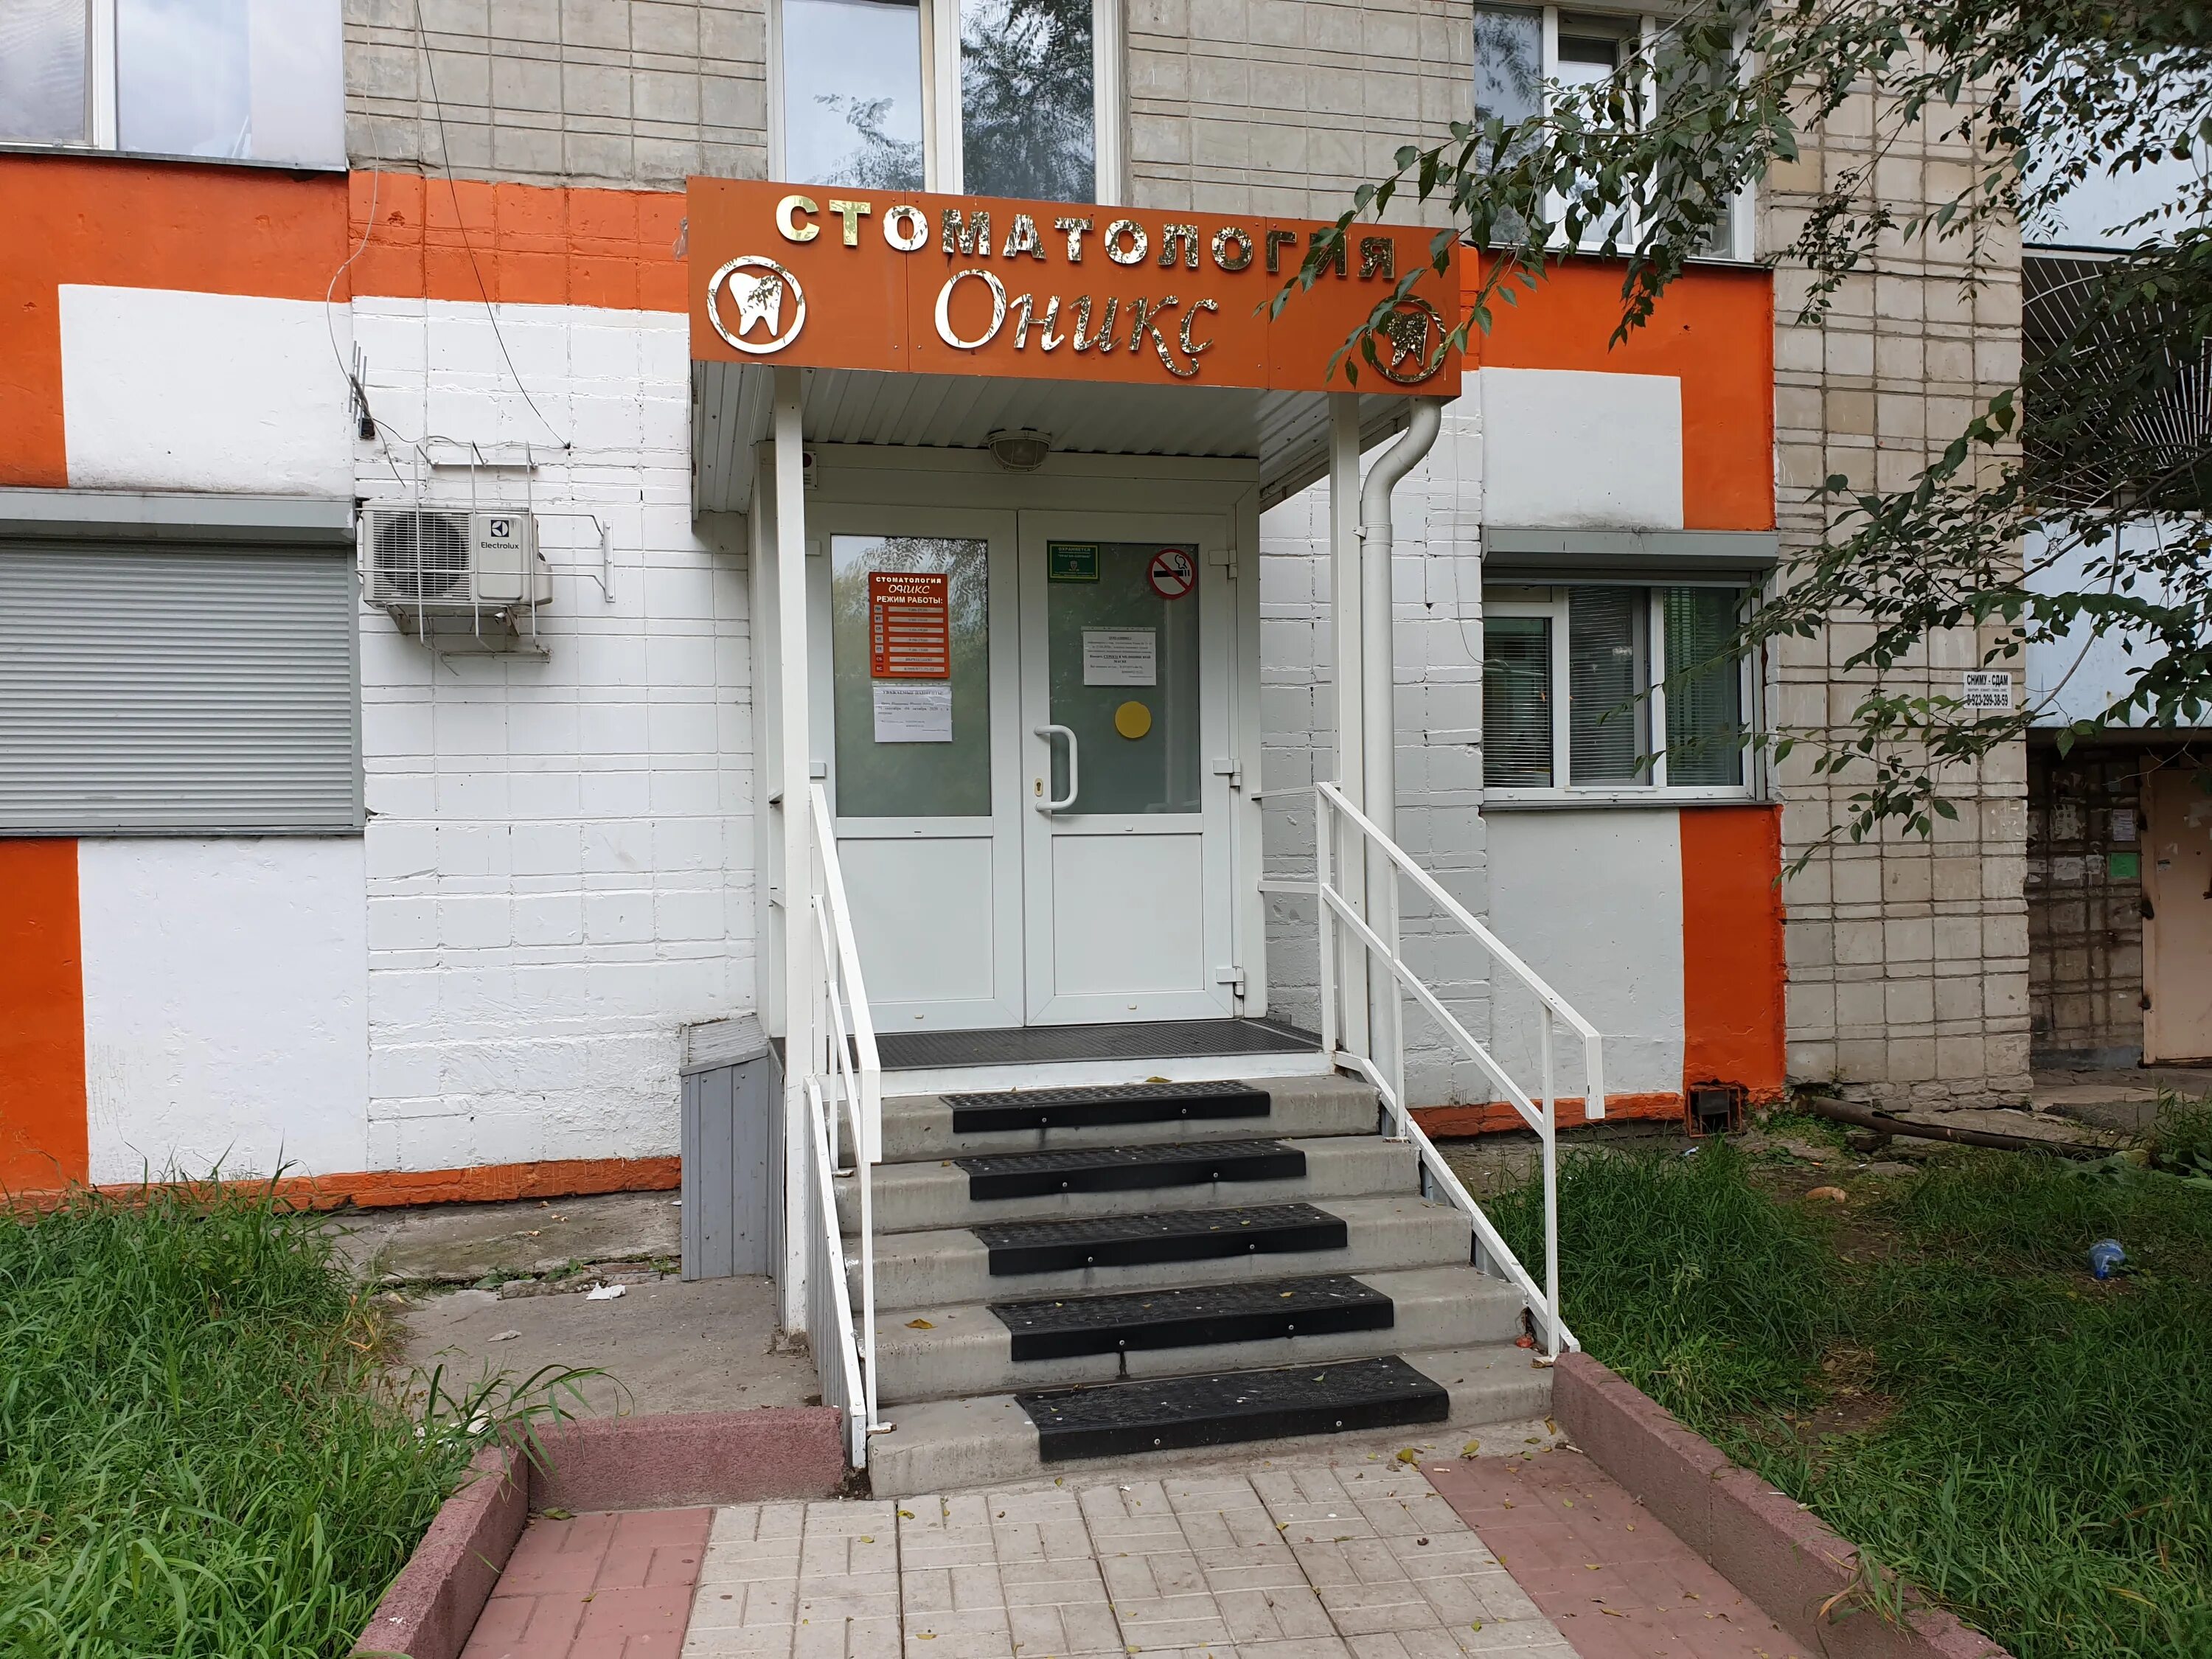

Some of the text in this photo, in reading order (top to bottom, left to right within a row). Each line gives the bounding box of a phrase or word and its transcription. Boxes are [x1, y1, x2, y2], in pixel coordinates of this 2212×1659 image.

[776, 195, 1396, 279] СТОМАТОЛОГИЯ
[934, 268, 1219, 378] Оникс
[907, 597, 943, 605] РАБОТЫ:
[1966, 675, 1987, 686] СНИМУ
[1992, 675, 2008, 687] СДАМ
